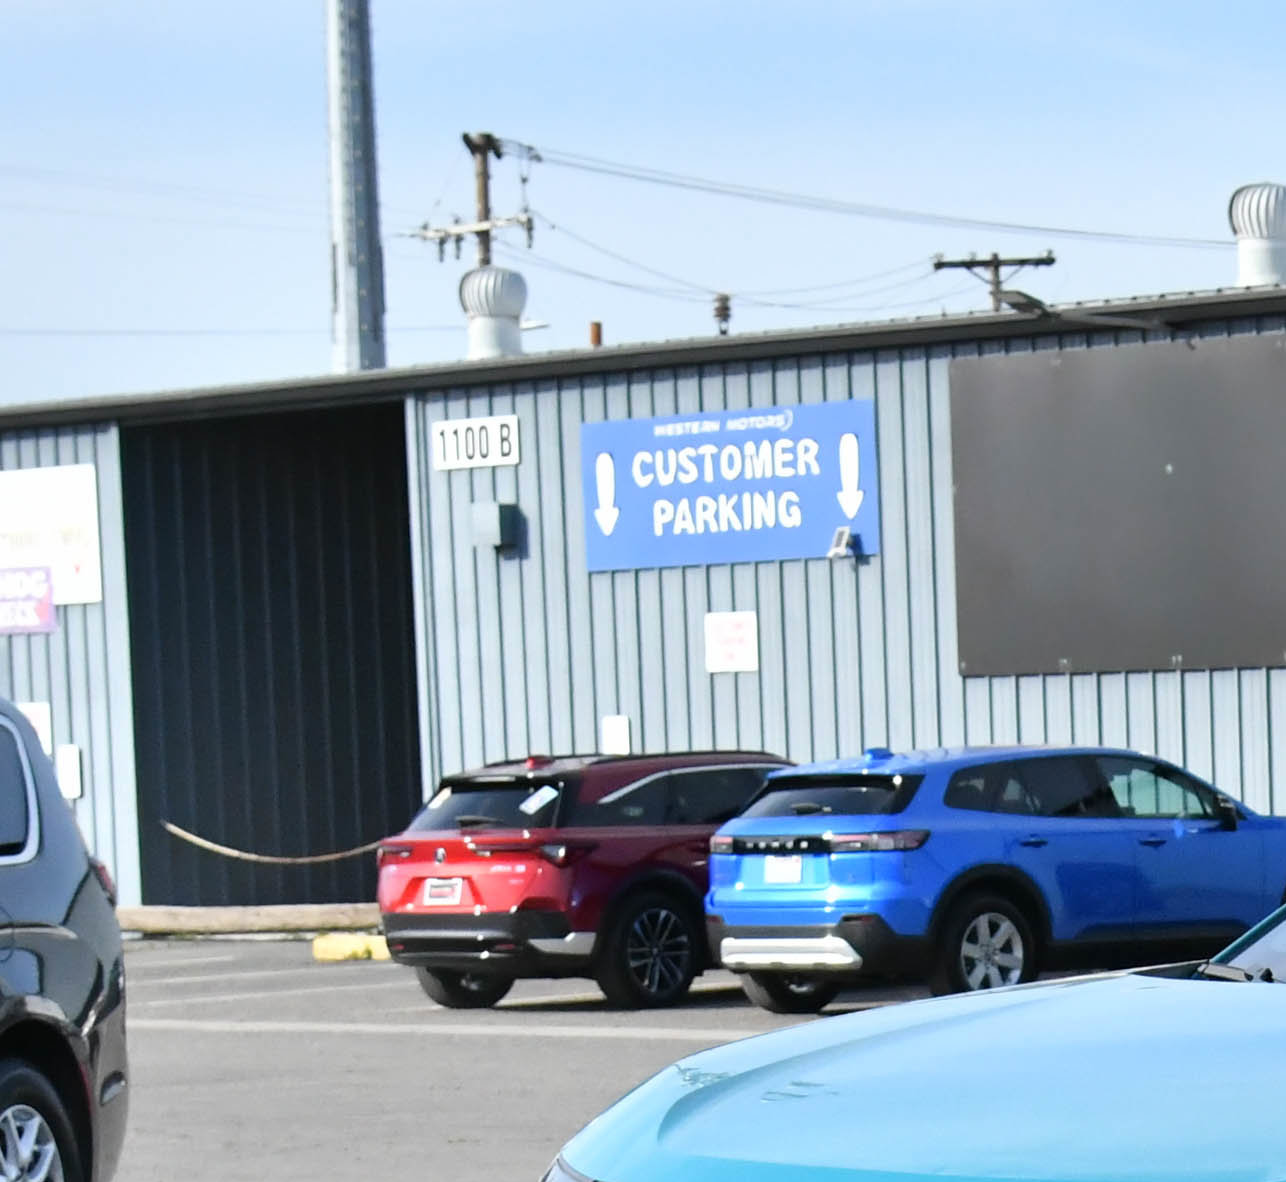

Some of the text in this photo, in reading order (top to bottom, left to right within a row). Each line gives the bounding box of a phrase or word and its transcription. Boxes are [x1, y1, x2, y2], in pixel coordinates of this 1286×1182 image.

[439, 422, 512, 463] 1100 B
[631, 438, 821, 488] CUSTOMER
[653, 491, 802, 537] PARKING
